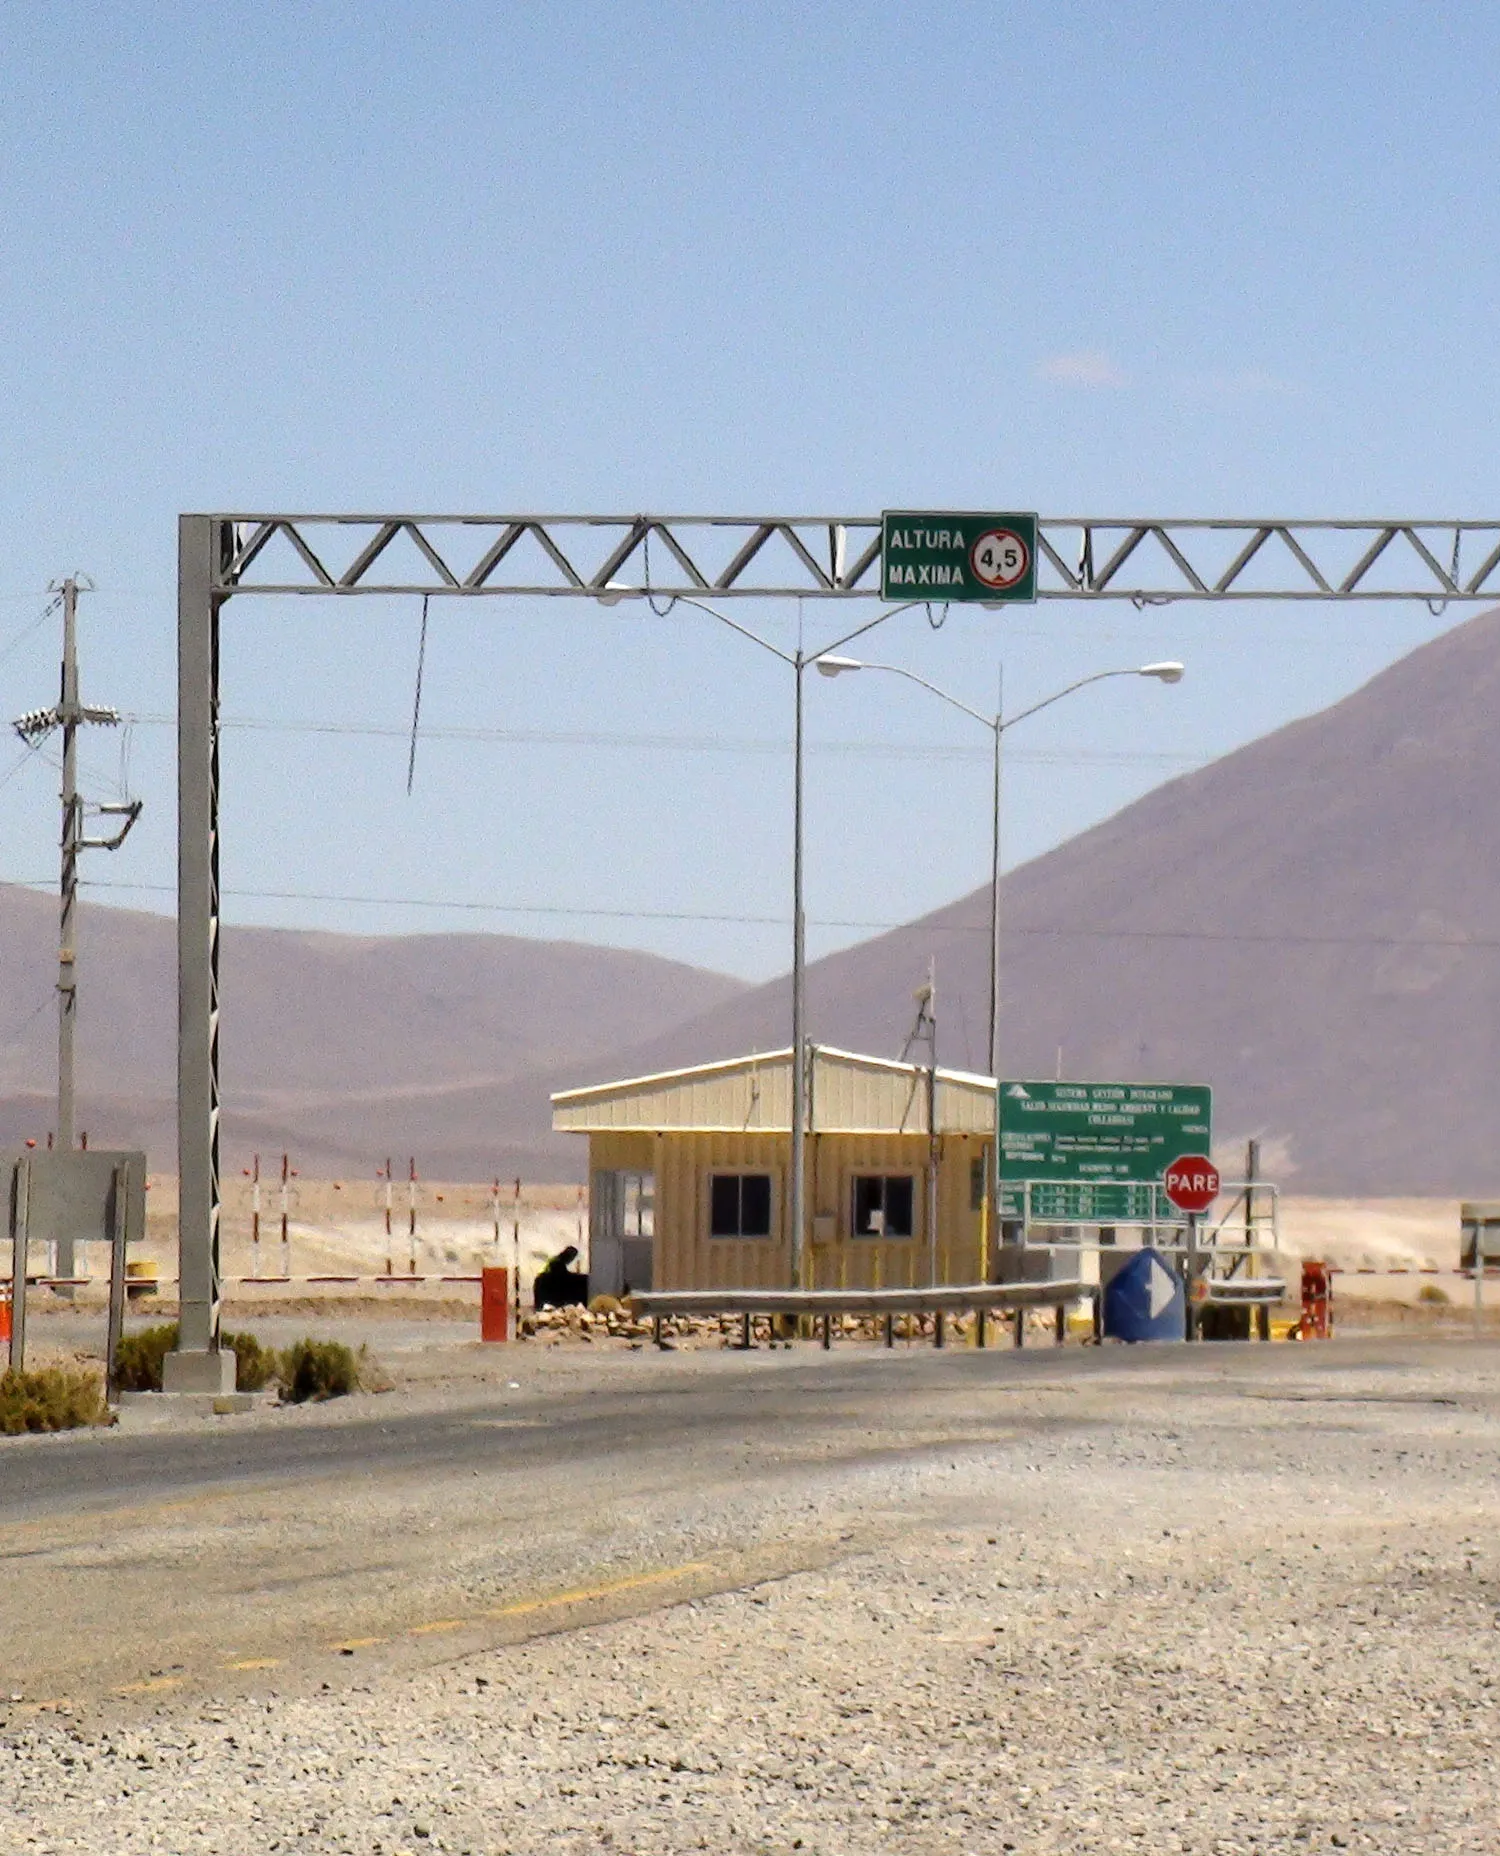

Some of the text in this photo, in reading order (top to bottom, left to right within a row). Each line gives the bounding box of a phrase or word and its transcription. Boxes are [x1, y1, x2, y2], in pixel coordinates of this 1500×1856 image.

[890, 530, 965, 549] ALTURA
[979, 549, 1018, 573] 4,5
[889, 565, 965, 585] MAXIMA
[1167, 1174, 1218, 1192] PARE
